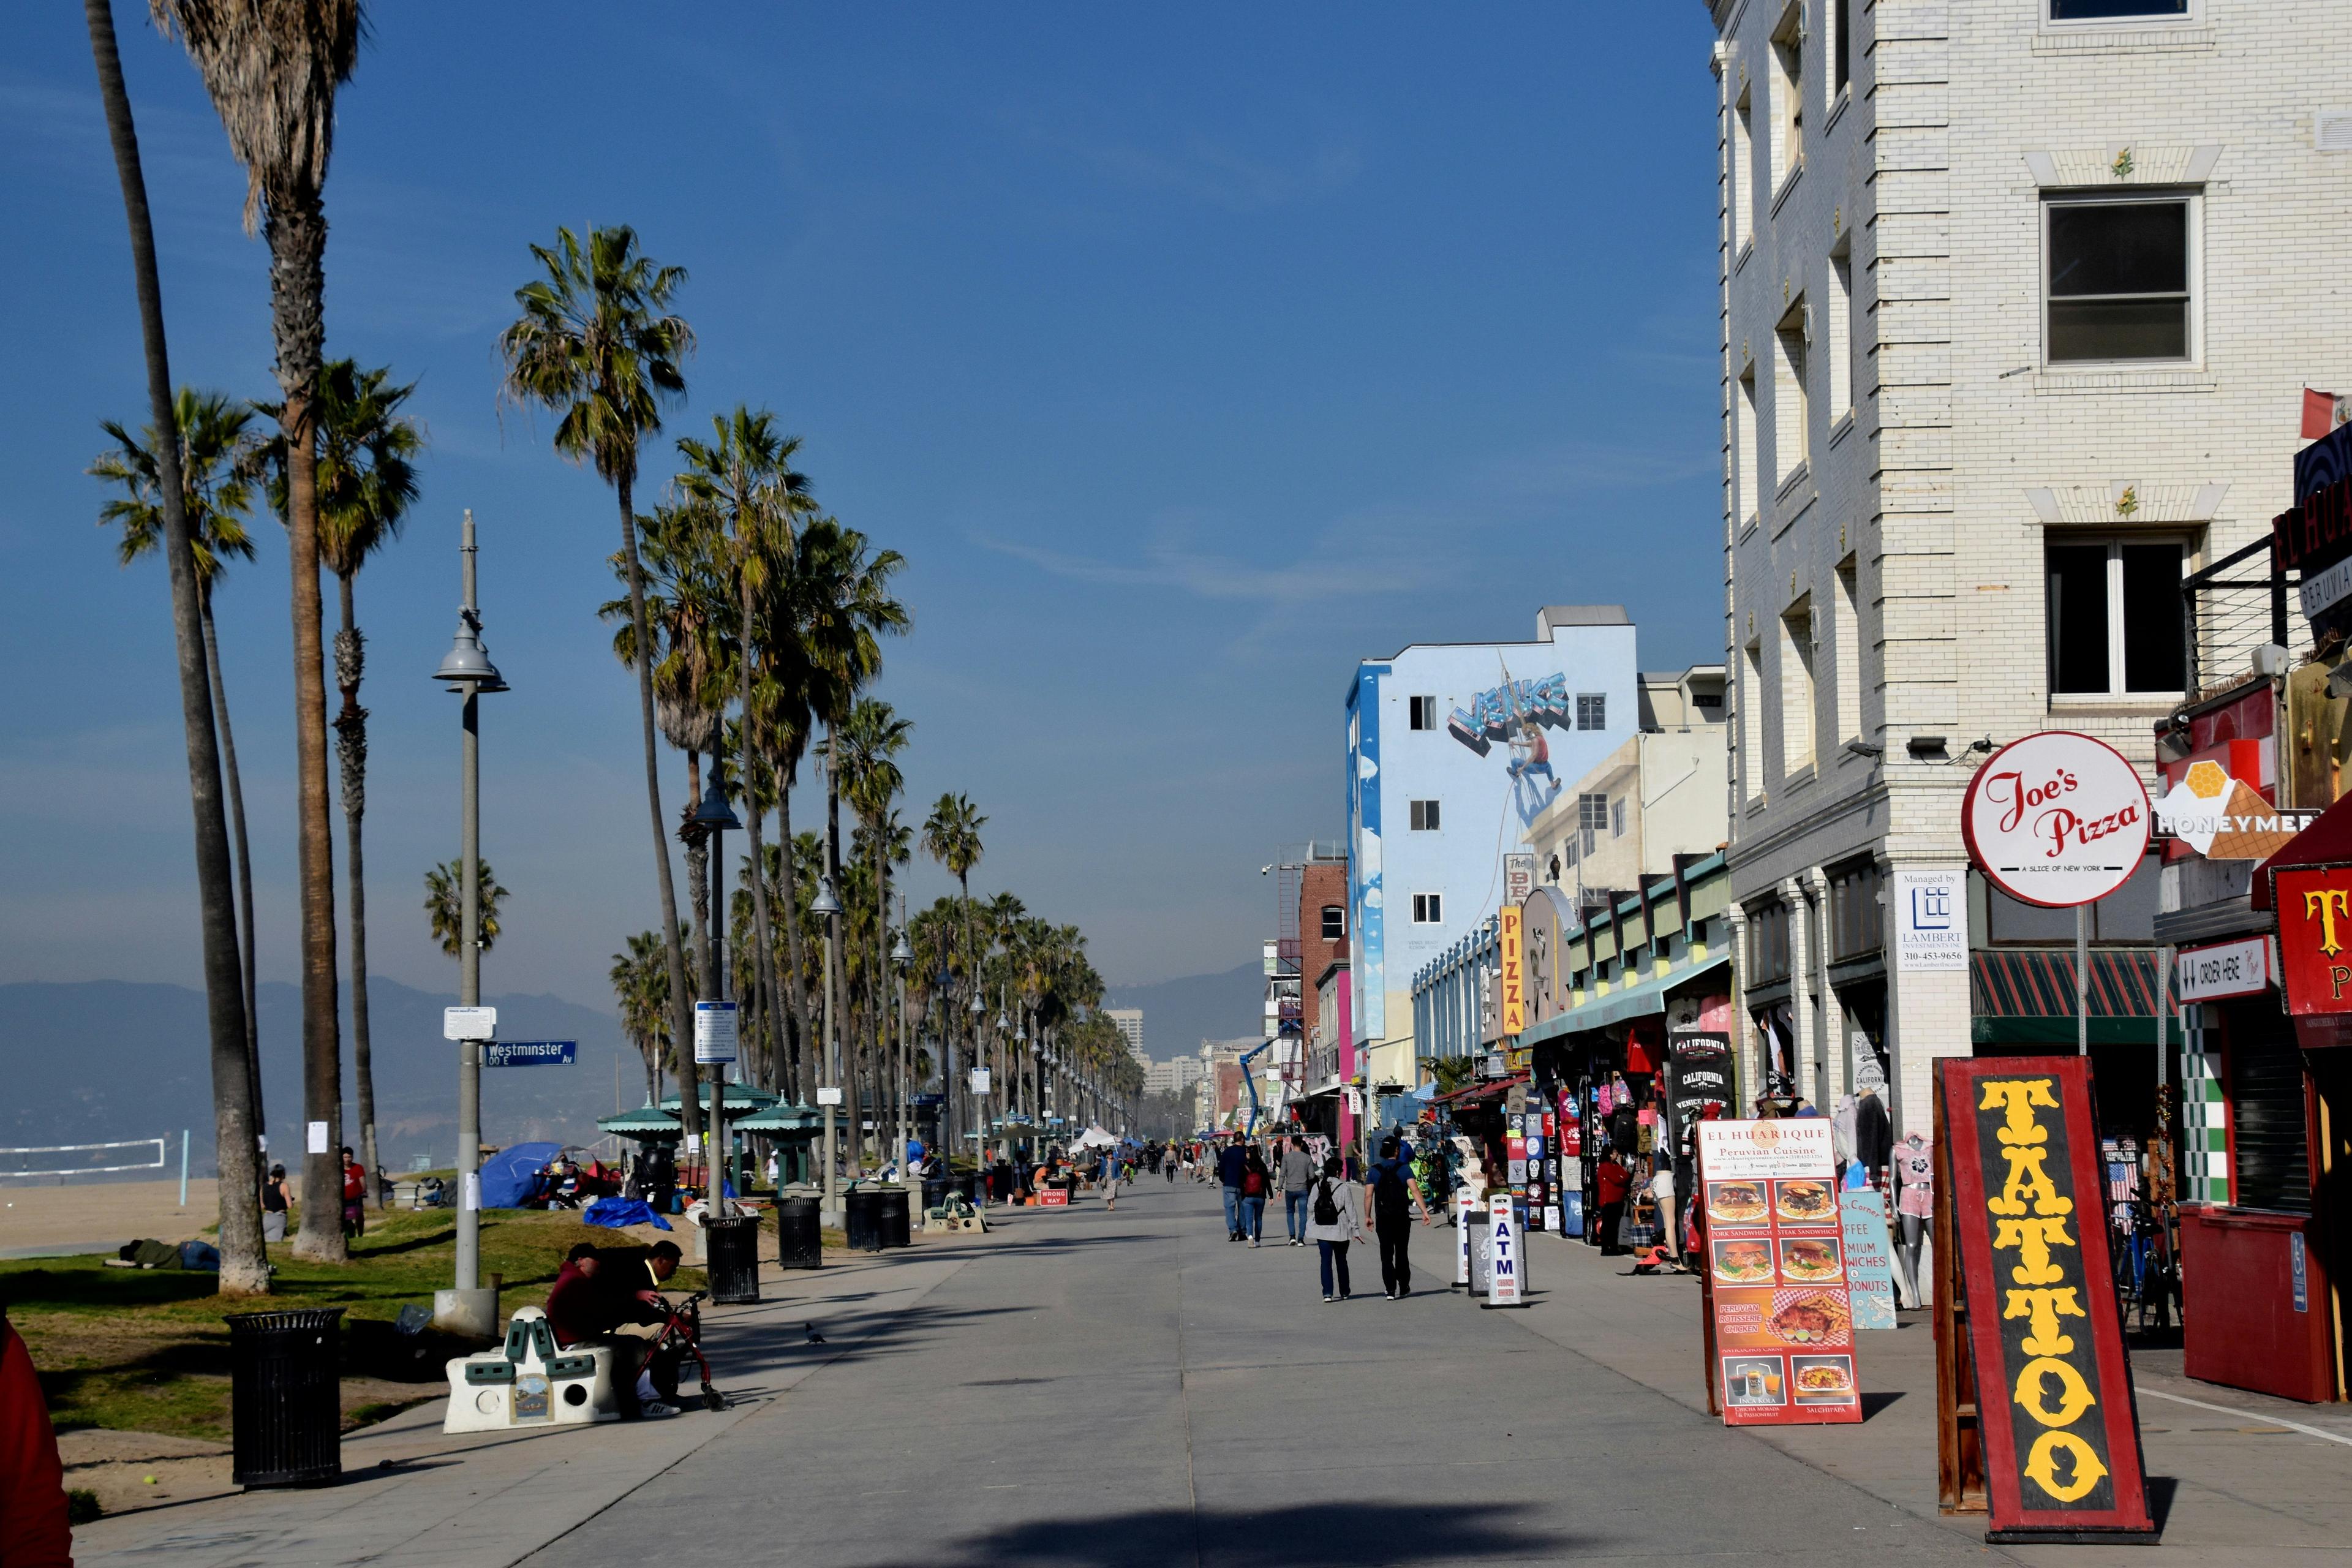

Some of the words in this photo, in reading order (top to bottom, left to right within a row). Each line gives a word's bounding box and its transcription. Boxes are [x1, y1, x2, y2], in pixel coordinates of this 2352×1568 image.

[2302, 556, 2352, 609] PERUVIA
[1986, 768, 2078, 833] Joe's
[2034, 804, 2140, 858] Pizza
[1509, 858, 1526, 868] The
[1904, 875, 1942, 884] Managed
[1946, 875, 1956, 883] by
[1902, 932, 1962, 943] LAMBERT
[1904, 952, 1962, 960] 310-453-9656
[1504, 914, 1521, 1027] PIZZA
[2199, 959, 2221, 985] ORDER
[2222, 956, 2240, 981] HERE
[489, 1042, 564, 1057] Westminster
[489, 1057, 500, 1065] 00
[503, 1056, 509, 1065] E
[562, 1055, 572, 1064] Av
[1683, 1071, 1724, 1085] CALIFORNIA
[1676, 1098, 1702, 1109] VENICE
[1708, 1131, 1725, 1140] EL
[1732, 1129, 1825, 1141] HUARIQUE
[1720, 1148, 1770, 1156] Peruvian
[1774, 1147, 1816, 1155] Cuisine
[1852, 1200, 1880, 1217] Corner
[1495, 1222, 1513, 1275] ATM
[1848, 1281, 1888, 1292] DONUTS
[1978, 1077, 2108, 1503] TATTOO
[1720, 1303, 1760, 1313] PERUVIAN
[1719, 1314, 1762, 1323] ROTISSERIE
[1724, 1325, 1759, 1333] CHICKEN
